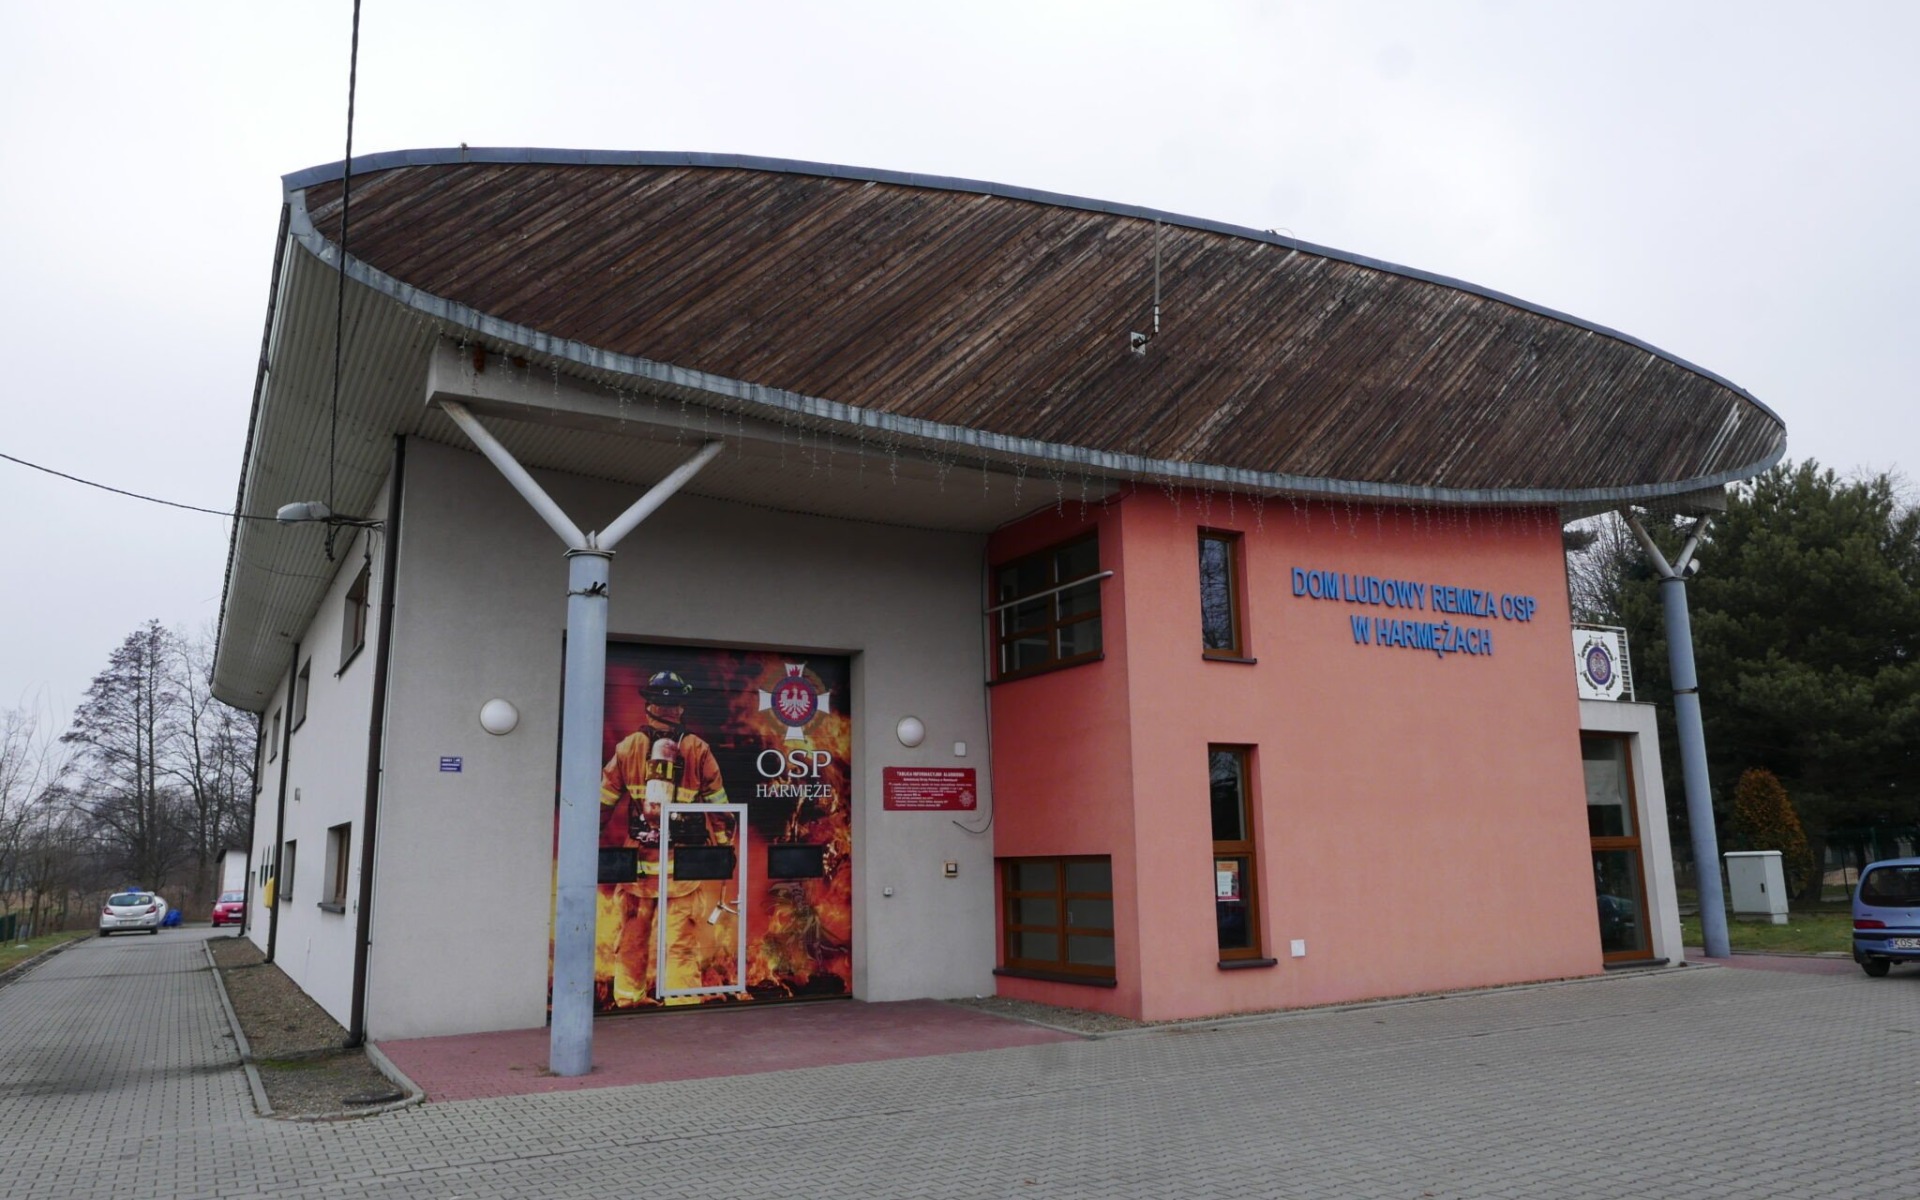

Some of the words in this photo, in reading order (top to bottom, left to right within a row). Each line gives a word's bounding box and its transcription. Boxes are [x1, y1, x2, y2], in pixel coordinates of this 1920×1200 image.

[1292, 567, 1339, 599] DOM
[1343, 574, 1426, 610] LUDOWY
[1431, 585, 1497, 618] REMIZA
[1500, 594, 1536, 622] OSP
[1351, 615, 1370, 643] W
[1376, 618, 1491, 658] HARMĘŻACH
[756, 749, 832, 778] OSP
[756, 782, 832, 800] HARMĘŻE
[1894, 938, 1913, 947] KOS
